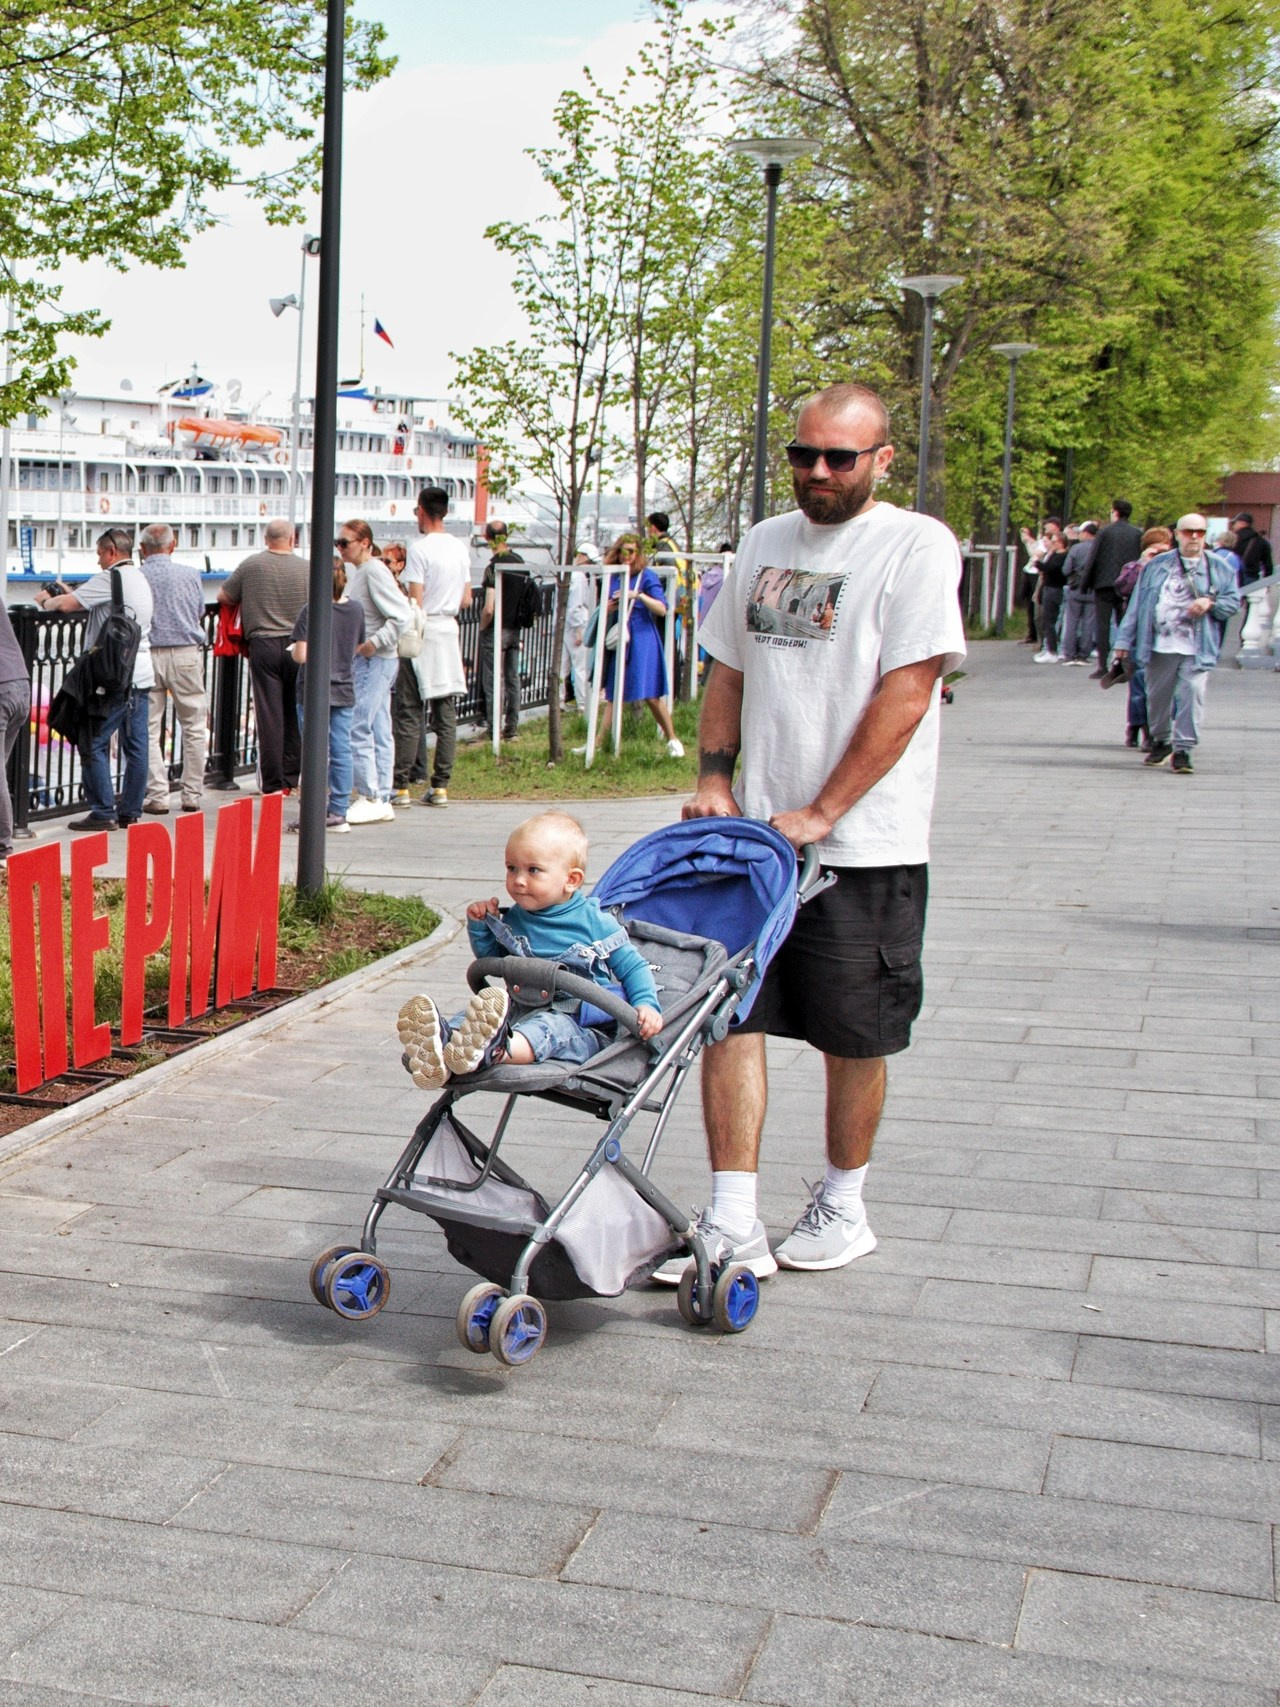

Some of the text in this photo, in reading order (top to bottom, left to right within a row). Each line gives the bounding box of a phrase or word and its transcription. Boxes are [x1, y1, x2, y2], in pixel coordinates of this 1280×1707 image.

[754, 634, 772, 644] ЧЕРТ
[772, 637, 808, 648] ПОБЕРИ!
[6, 791, 284, 1096] ПЕРМИ
